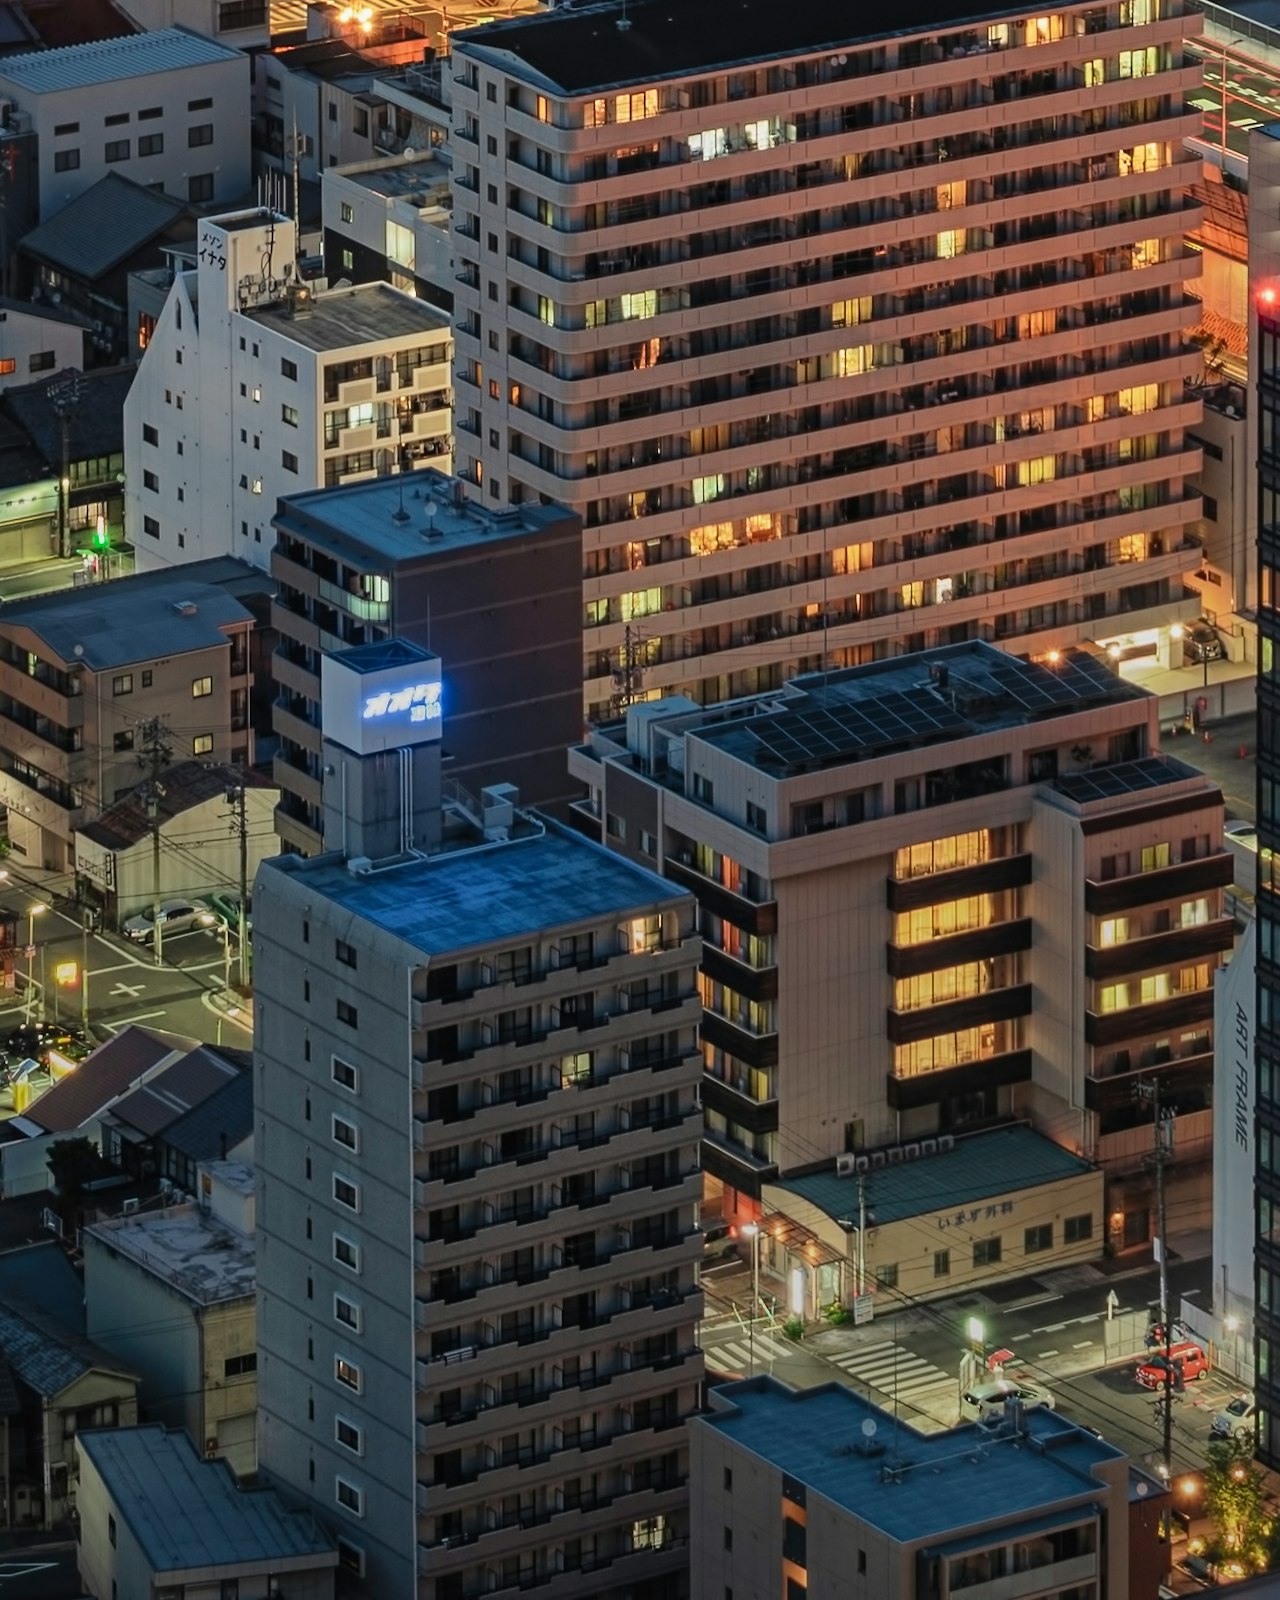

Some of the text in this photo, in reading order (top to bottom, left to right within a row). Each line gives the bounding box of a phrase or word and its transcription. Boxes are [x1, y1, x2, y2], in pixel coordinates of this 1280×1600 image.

[199, 248, 227, 271] イナタ
[1235, 1001, 1249, 1153] ART FRAME
